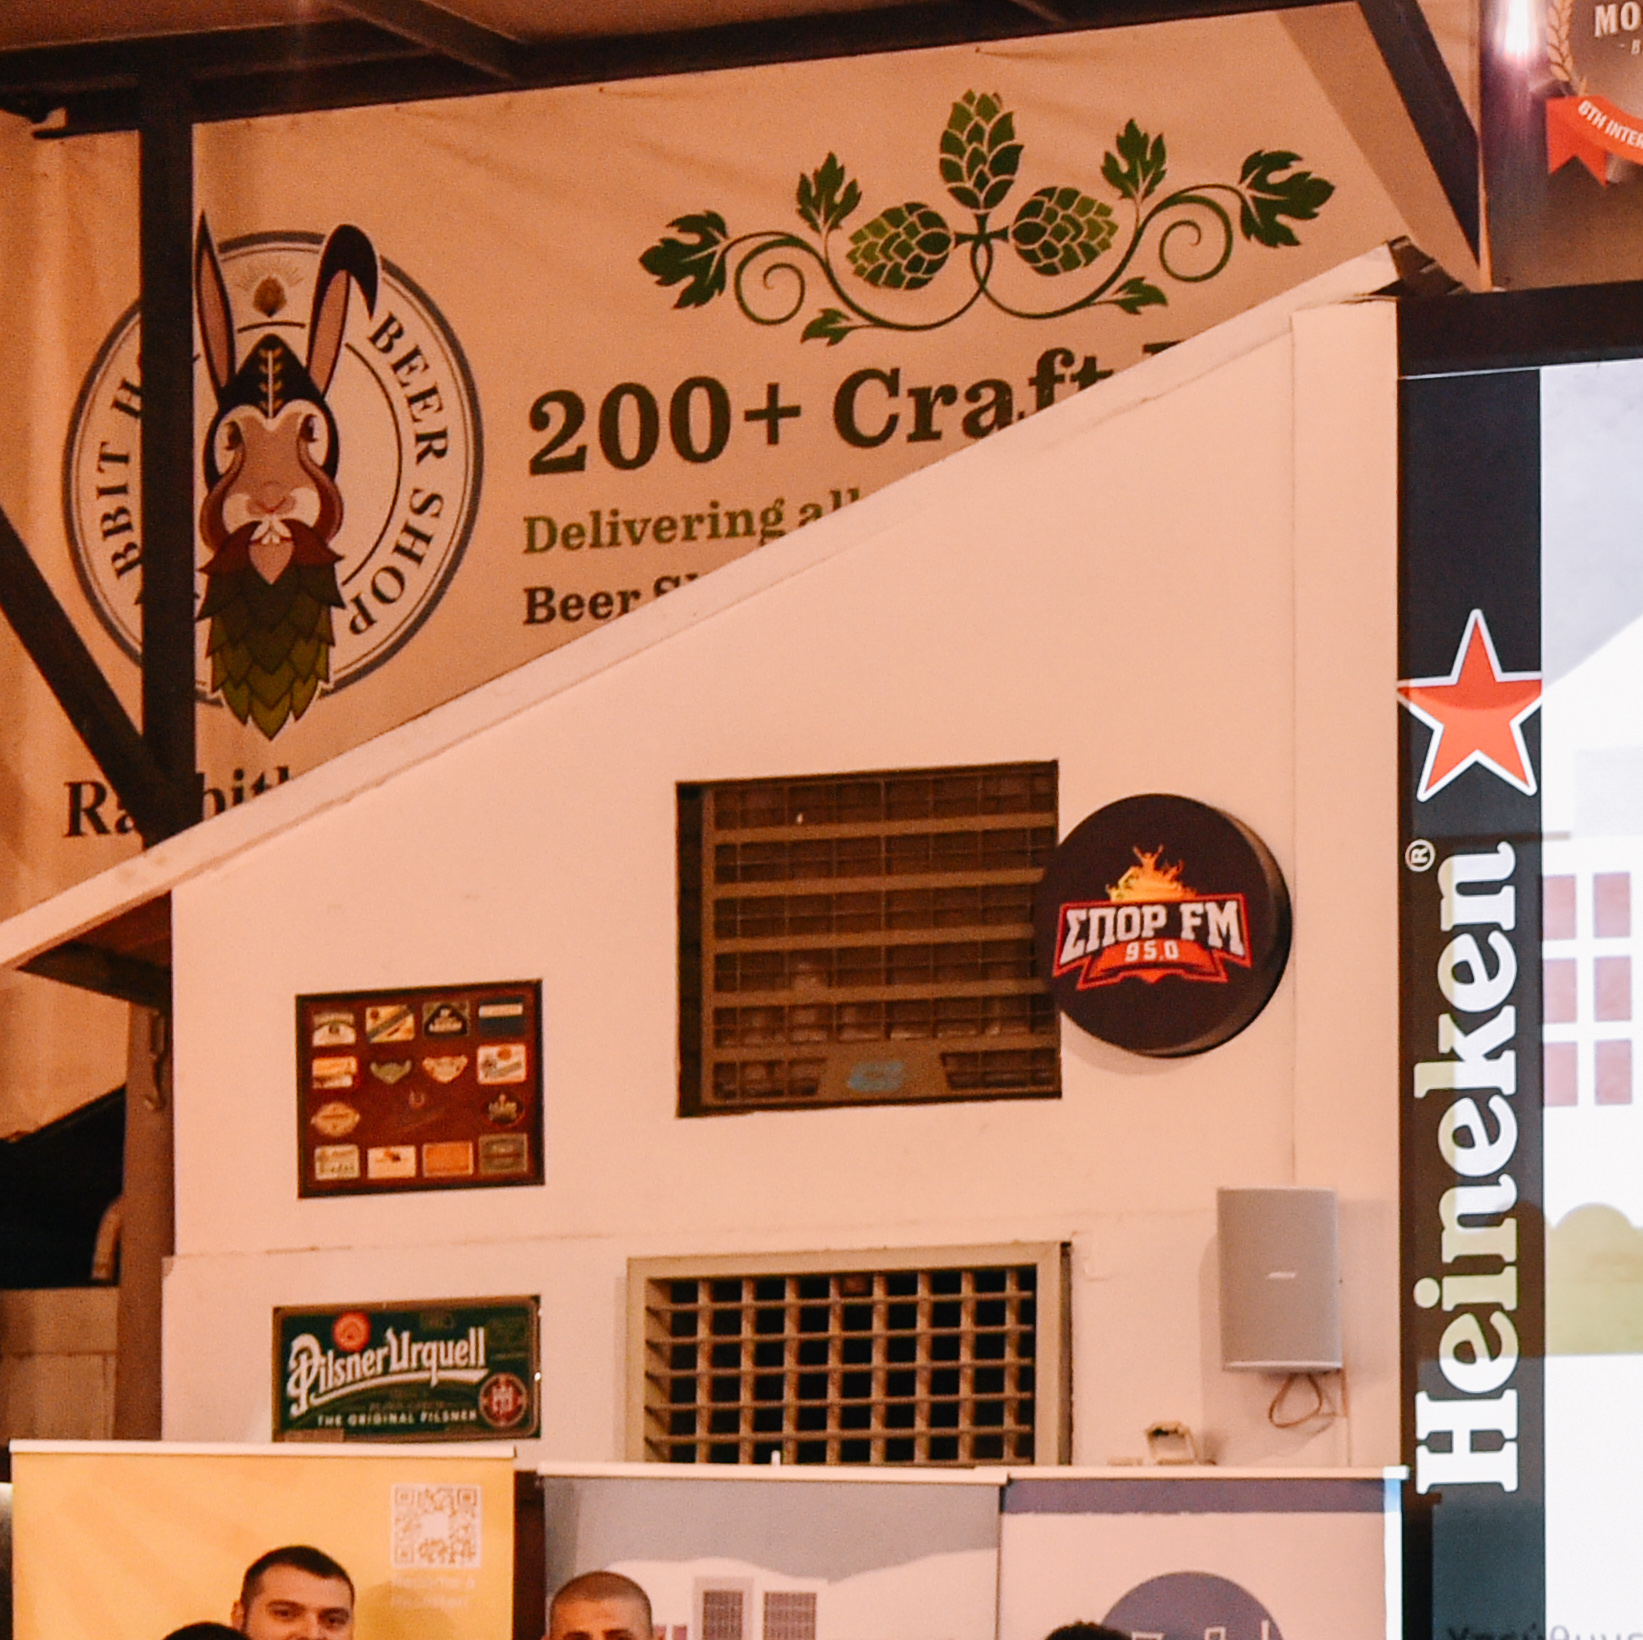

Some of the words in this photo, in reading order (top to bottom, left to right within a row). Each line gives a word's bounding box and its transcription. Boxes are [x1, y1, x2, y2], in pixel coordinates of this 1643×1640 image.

[367, 311, 449, 467] BEER
[528, 376, 802, 476] 200+
[349, 487, 444, 636] SHOP
[523, 498, 786, 555] Delivering
[523, 583, 642, 625] Beer
[1124, 940, 1180, 963] 95.0
[1180, 900, 1245, 957] FM
[1413, 840, 1520, 1494] Heineken
[286, 1332, 391, 1419] Pilsner
[386, 1326, 486, 1387] Urquell
[317, 1413, 342, 1427] THE
[347, 1411, 415, 1427] ORIGINAL
[420, 1408, 477, 1424] PILSNER
